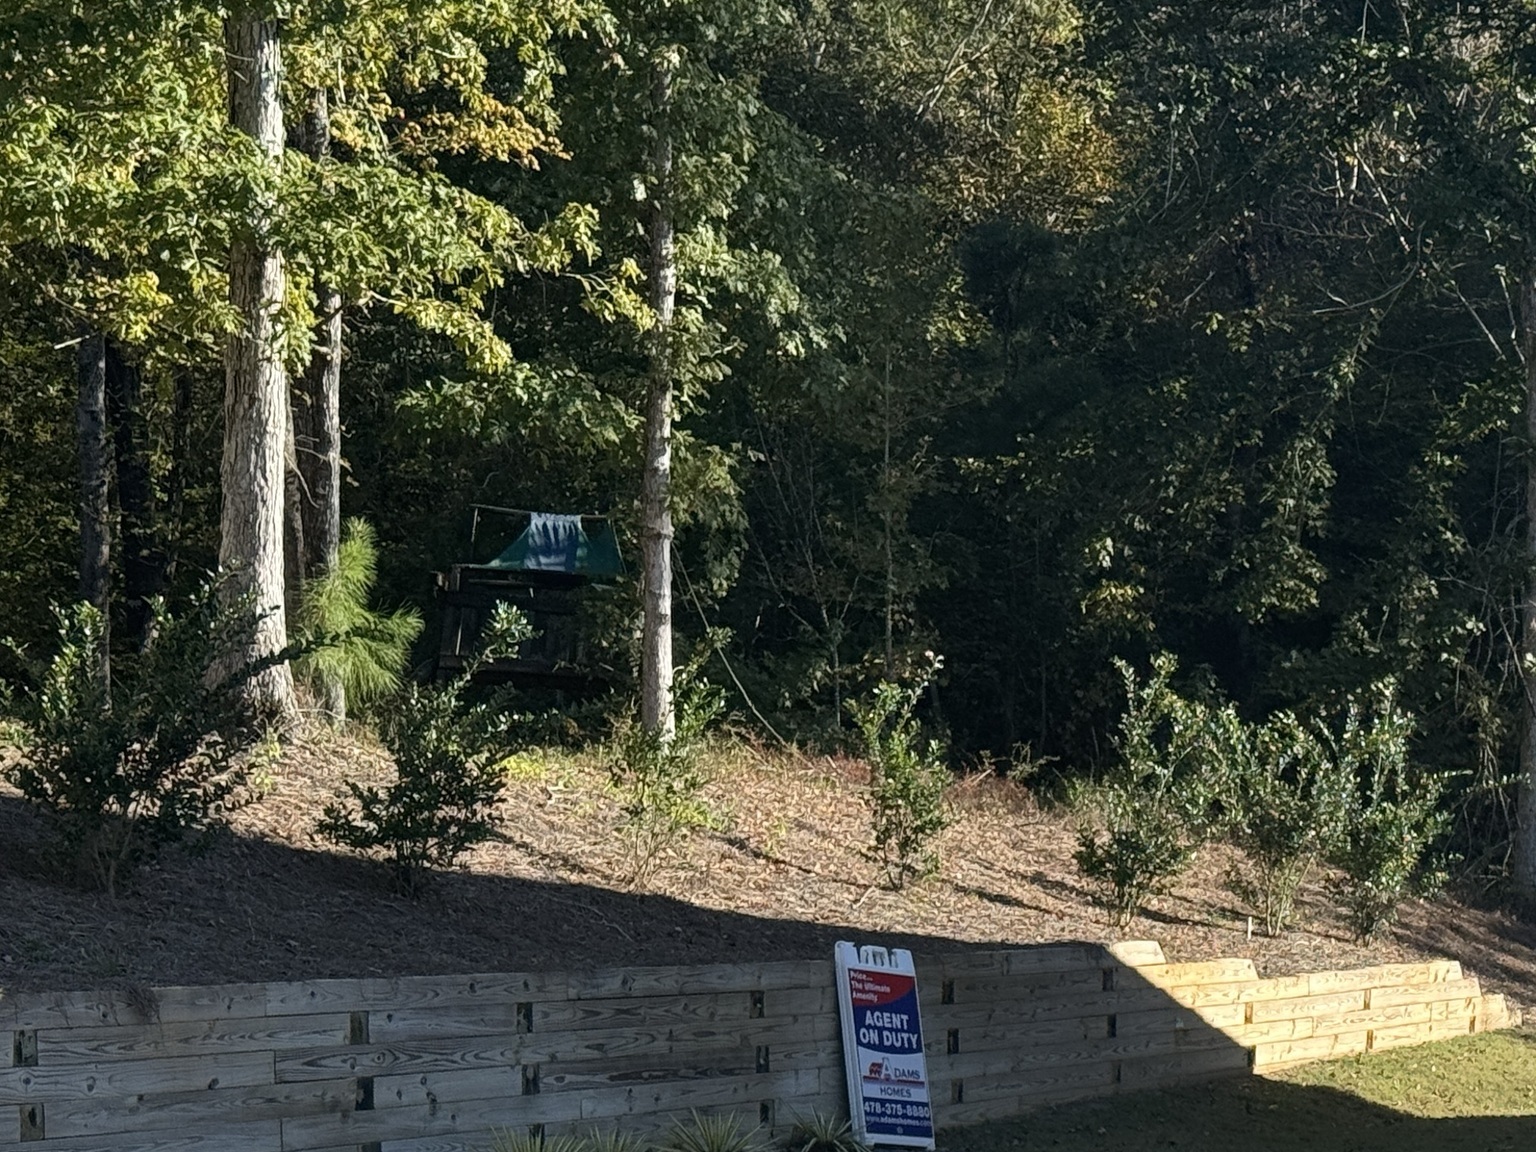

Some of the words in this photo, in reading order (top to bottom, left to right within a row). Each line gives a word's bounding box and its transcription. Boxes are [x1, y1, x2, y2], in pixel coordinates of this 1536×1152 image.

[851, 980, 863, 990] The
[864, 982, 891, 993] Ultimate
[865, 1010, 909, 1030] AGENT
[860, 1027, 879, 1045] ON
[883, 1030, 918, 1049] DUTY
[880, 1057, 920, 1079] ADAMS
[880, 1086, 912, 1098] HOMES
